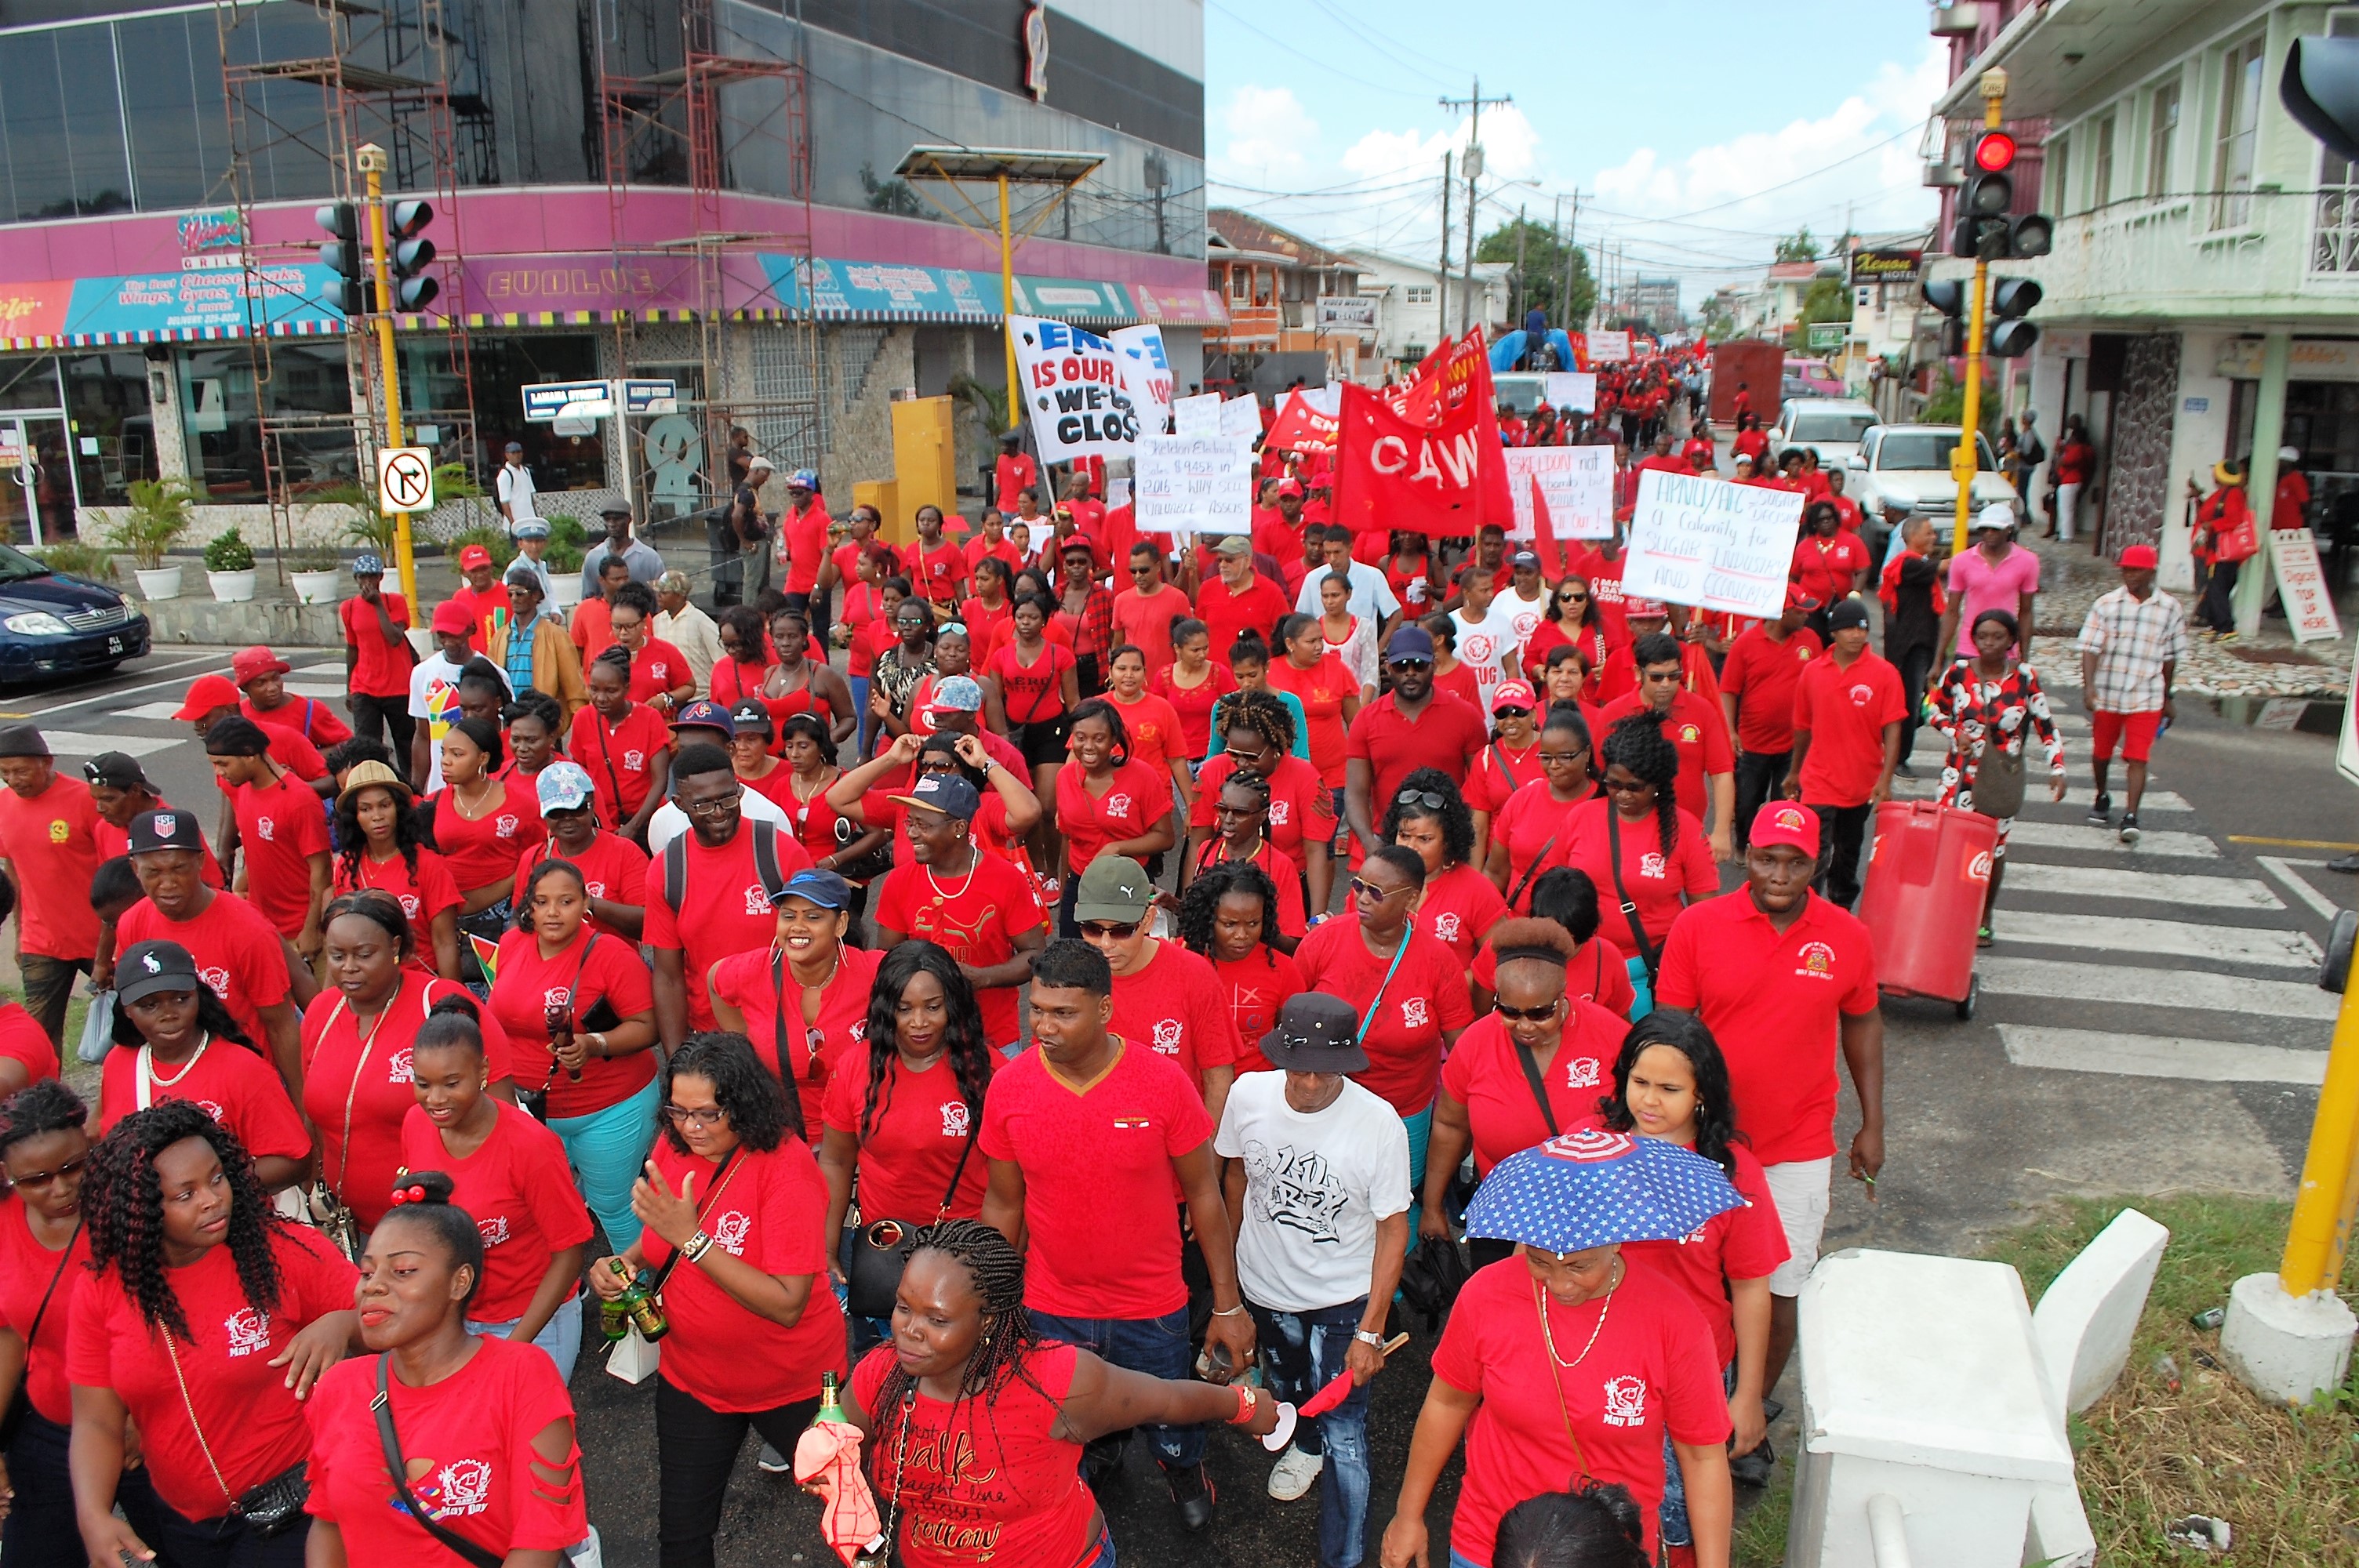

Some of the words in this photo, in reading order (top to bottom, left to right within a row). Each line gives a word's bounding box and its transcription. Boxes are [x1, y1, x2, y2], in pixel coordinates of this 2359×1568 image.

[1855, 252, 1912, 271] Xenon
[487, 269, 654, 296] EVOLVE
[1883, 270, 1918, 279] HOTEL
[119, 291, 173, 305] Wings,
[179, 287, 231, 303] Gyros,
[1031, 360, 1057, 390] IS
[1062, 357, 1114, 385] OUR
[1057, 412, 1140, 444] CLOS
[1143, 437, 1190, 456] Skeldon
[1510, 453, 1572, 476] SKELDON
[1579, 451, 1601, 471] not
[1646, 531, 1702, 557] SUGAR
[1710, 544, 1787, 579] INDUSTRY
[1654, 564, 1690, 590] AND
[154, 814, 176, 825] USA
[230, 1345, 251, 1357] May
[253, 1337, 271, 1352] Day
[1602, 1413, 1626, 1427] May
[1627, 1415, 1646, 1427] Day
[441, 1505, 466, 1516] May
[467, 1503, 489, 1515] Day
